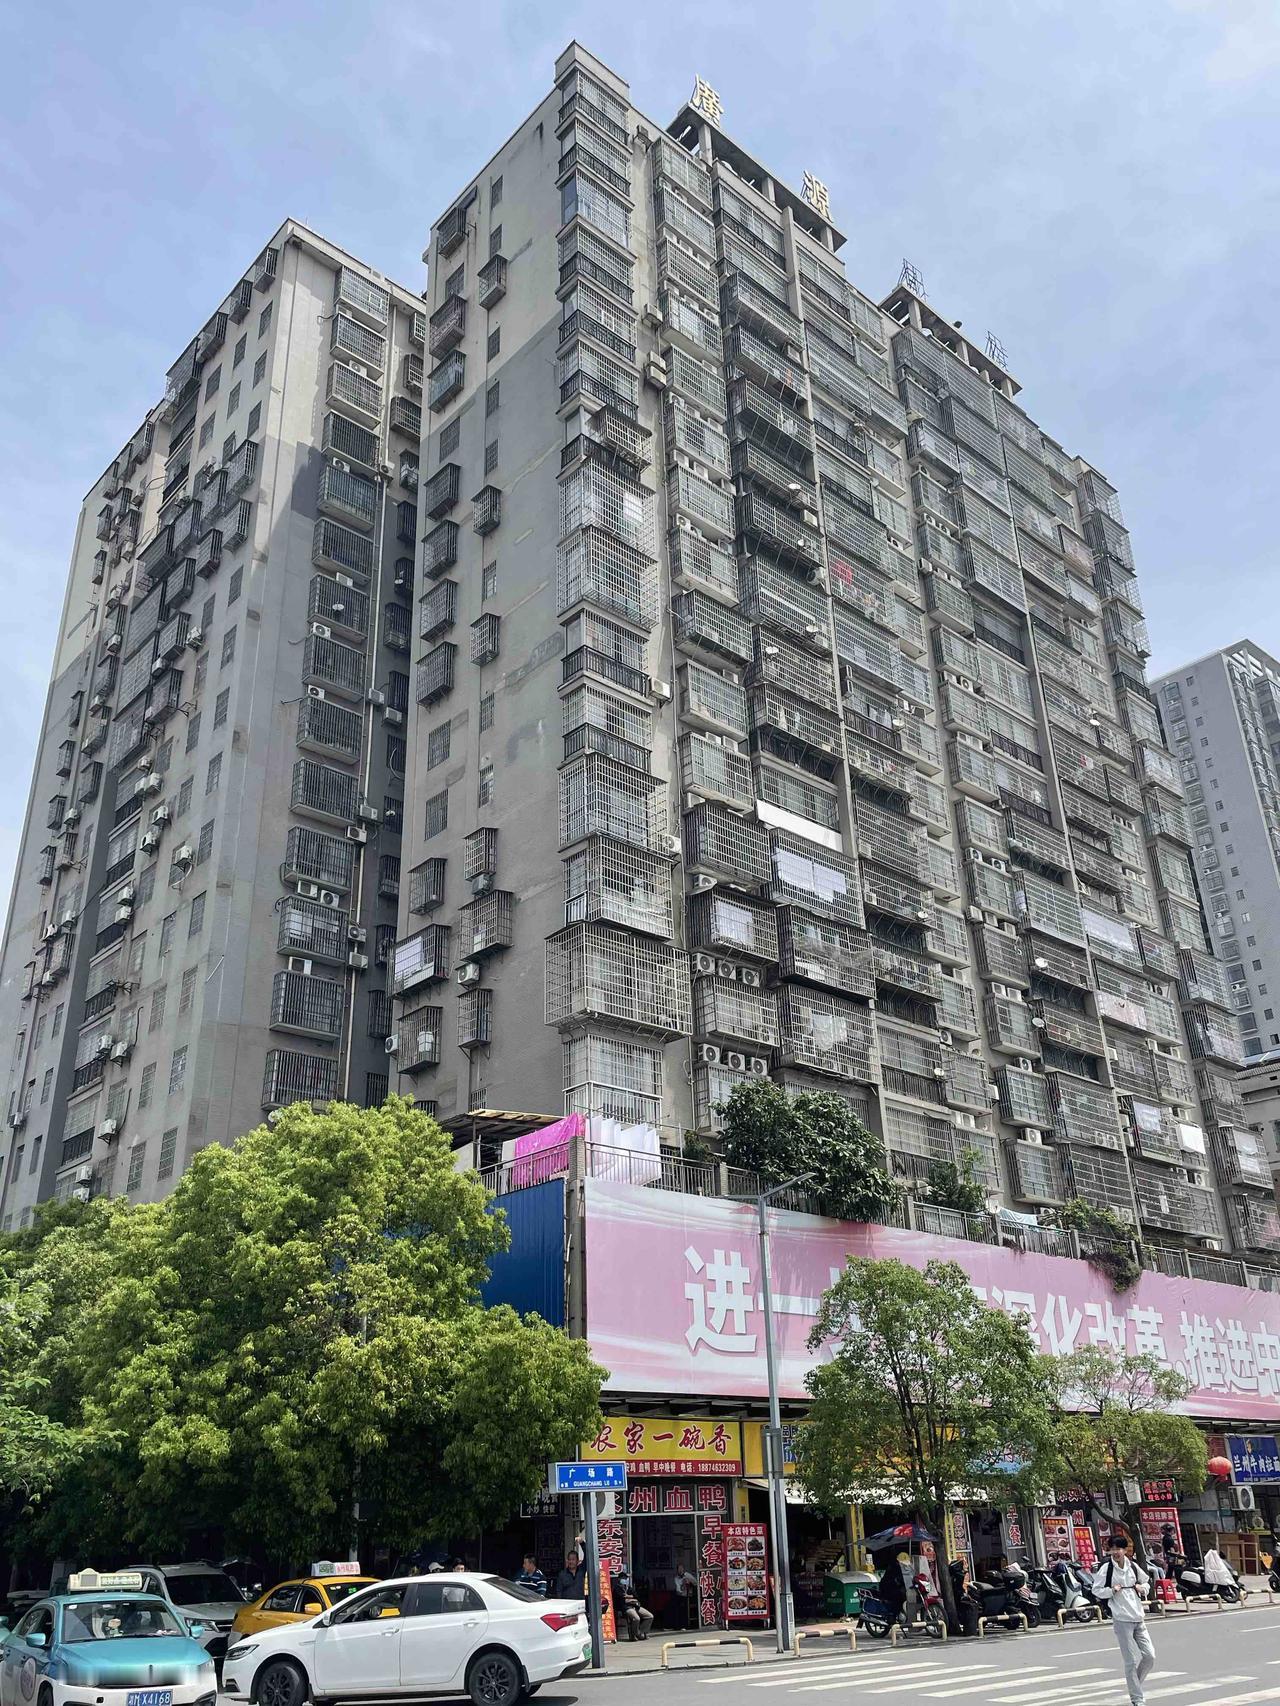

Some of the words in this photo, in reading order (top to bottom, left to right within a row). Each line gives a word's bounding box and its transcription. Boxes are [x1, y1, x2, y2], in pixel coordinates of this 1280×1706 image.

[590, 1421, 732, 1456] 农家一碗香
[568, 1466, 614, 1479] 广场路
[653, 1462, 676, 1473] 早中晚餐
[727, 1526, 764, 1536] 本店特色菜
[700, 1570, 717, 1626] 快餐
